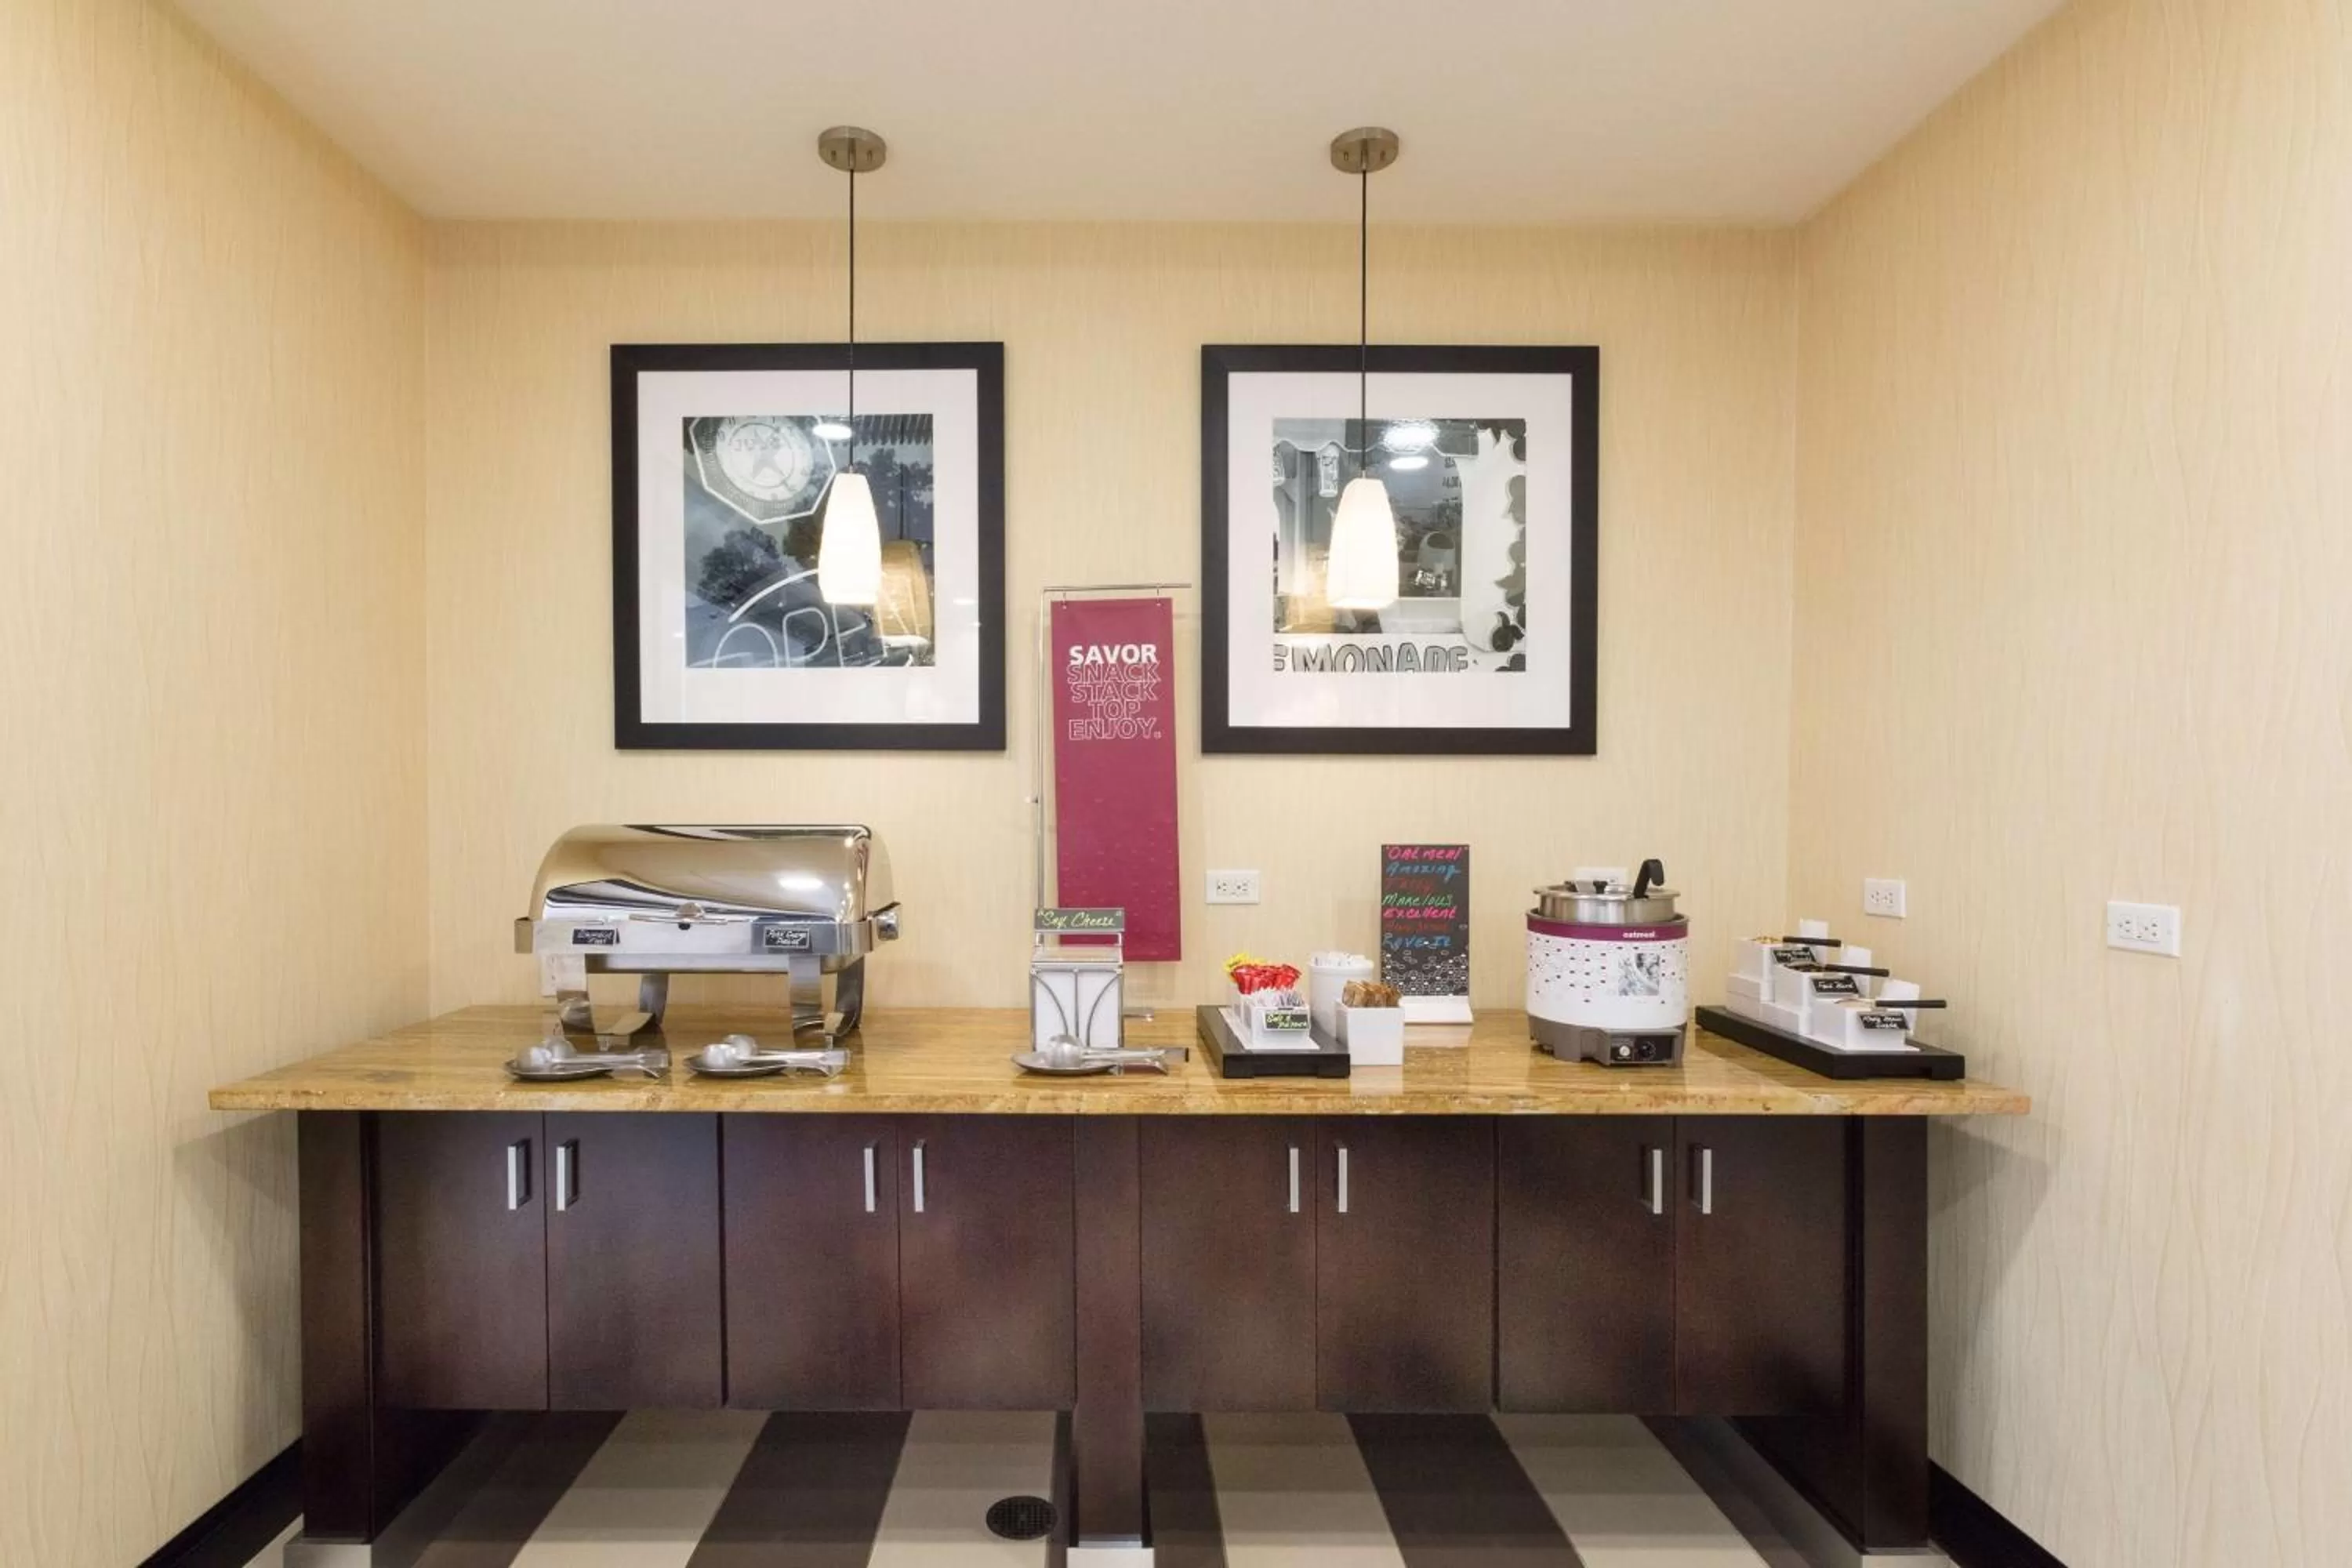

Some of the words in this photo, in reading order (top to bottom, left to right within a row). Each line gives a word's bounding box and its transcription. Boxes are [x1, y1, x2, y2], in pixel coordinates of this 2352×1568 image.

[1069, 644, 1158, 665] SAVOR
[1066, 662, 1161, 684] SNACK
[1071, 681, 1159, 703] STACK
[1087, 699, 1142, 720] TOP
[1623, 930, 1656, 938] oatmeal
